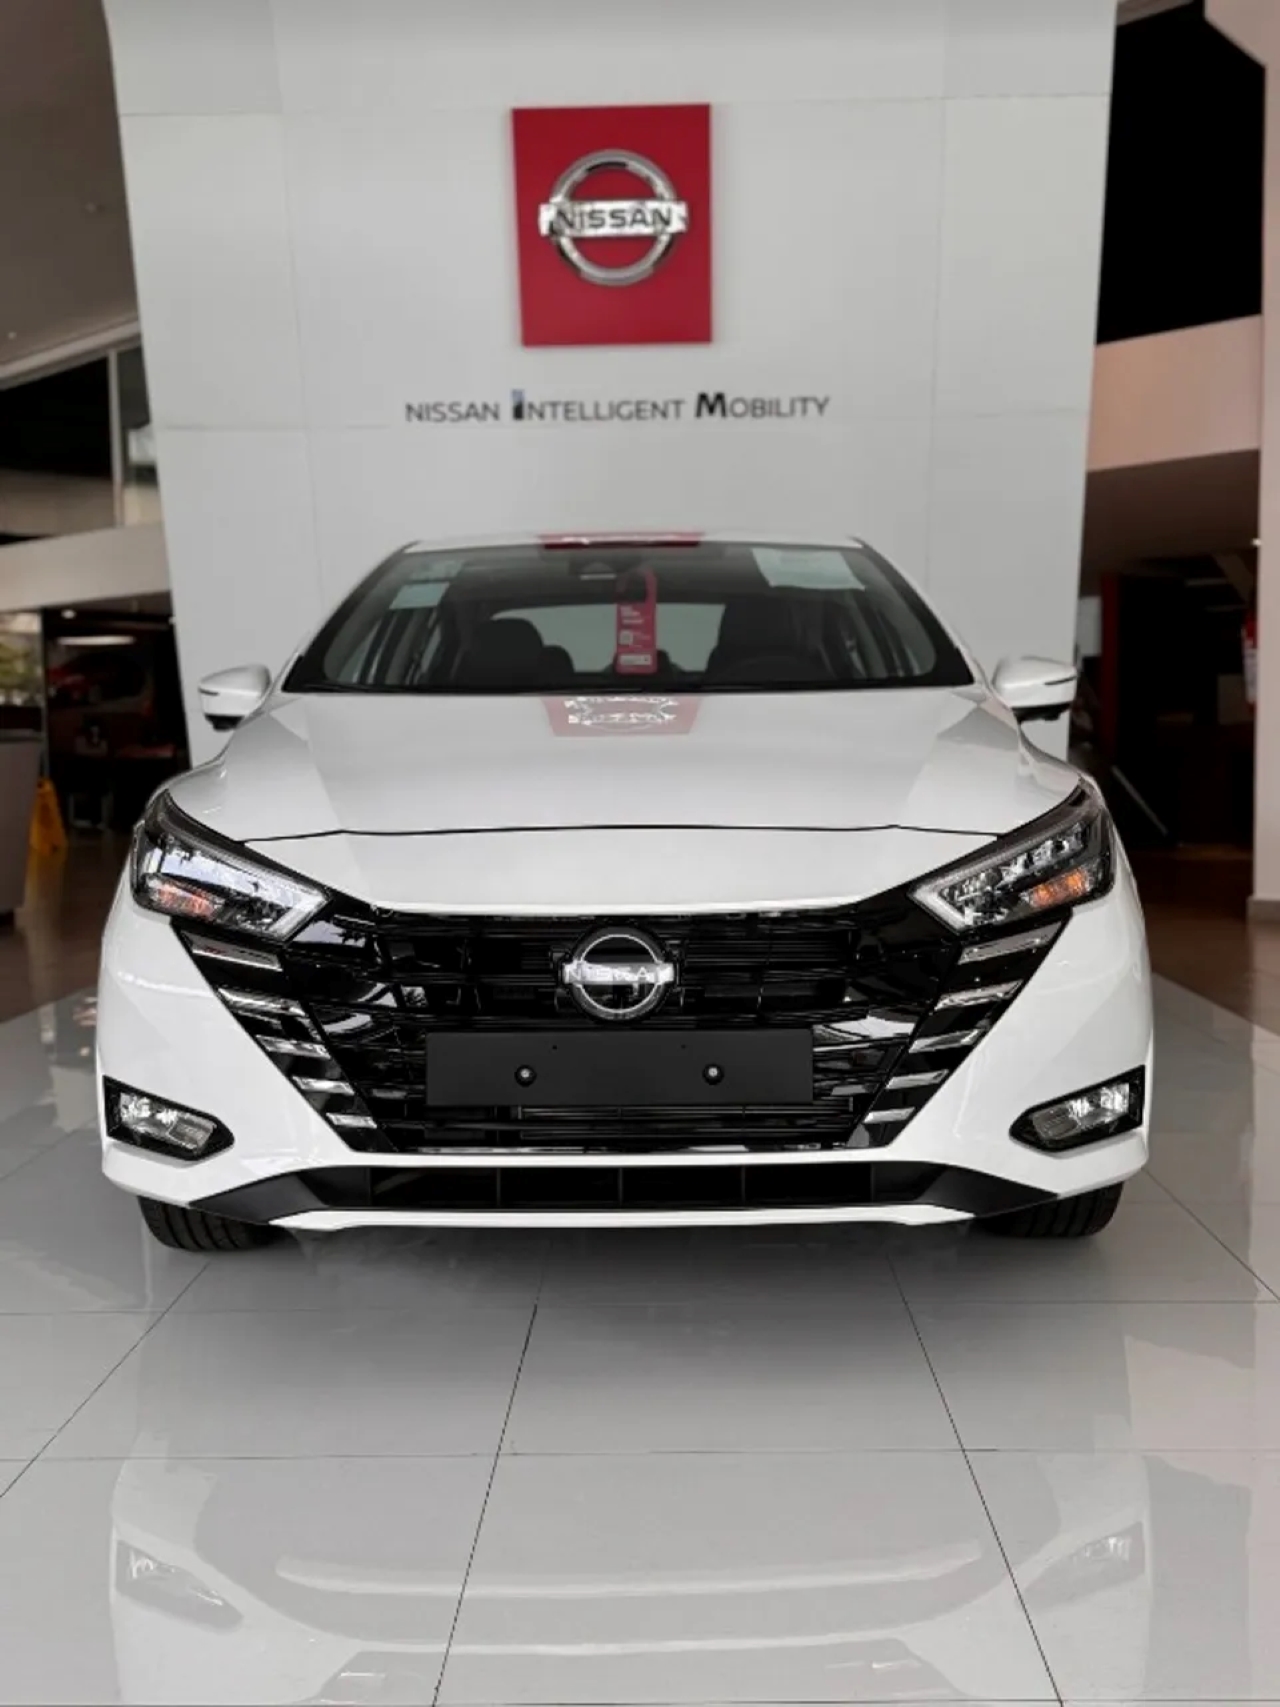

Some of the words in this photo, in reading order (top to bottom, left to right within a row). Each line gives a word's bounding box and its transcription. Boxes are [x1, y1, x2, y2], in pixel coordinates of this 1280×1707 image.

[556, 207, 672, 229] NISSAN
[404, 402, 499, 422] NISSAN
[695, 391, 830, 420] MOBILITY
[564, 963, 674, 984] NSA
